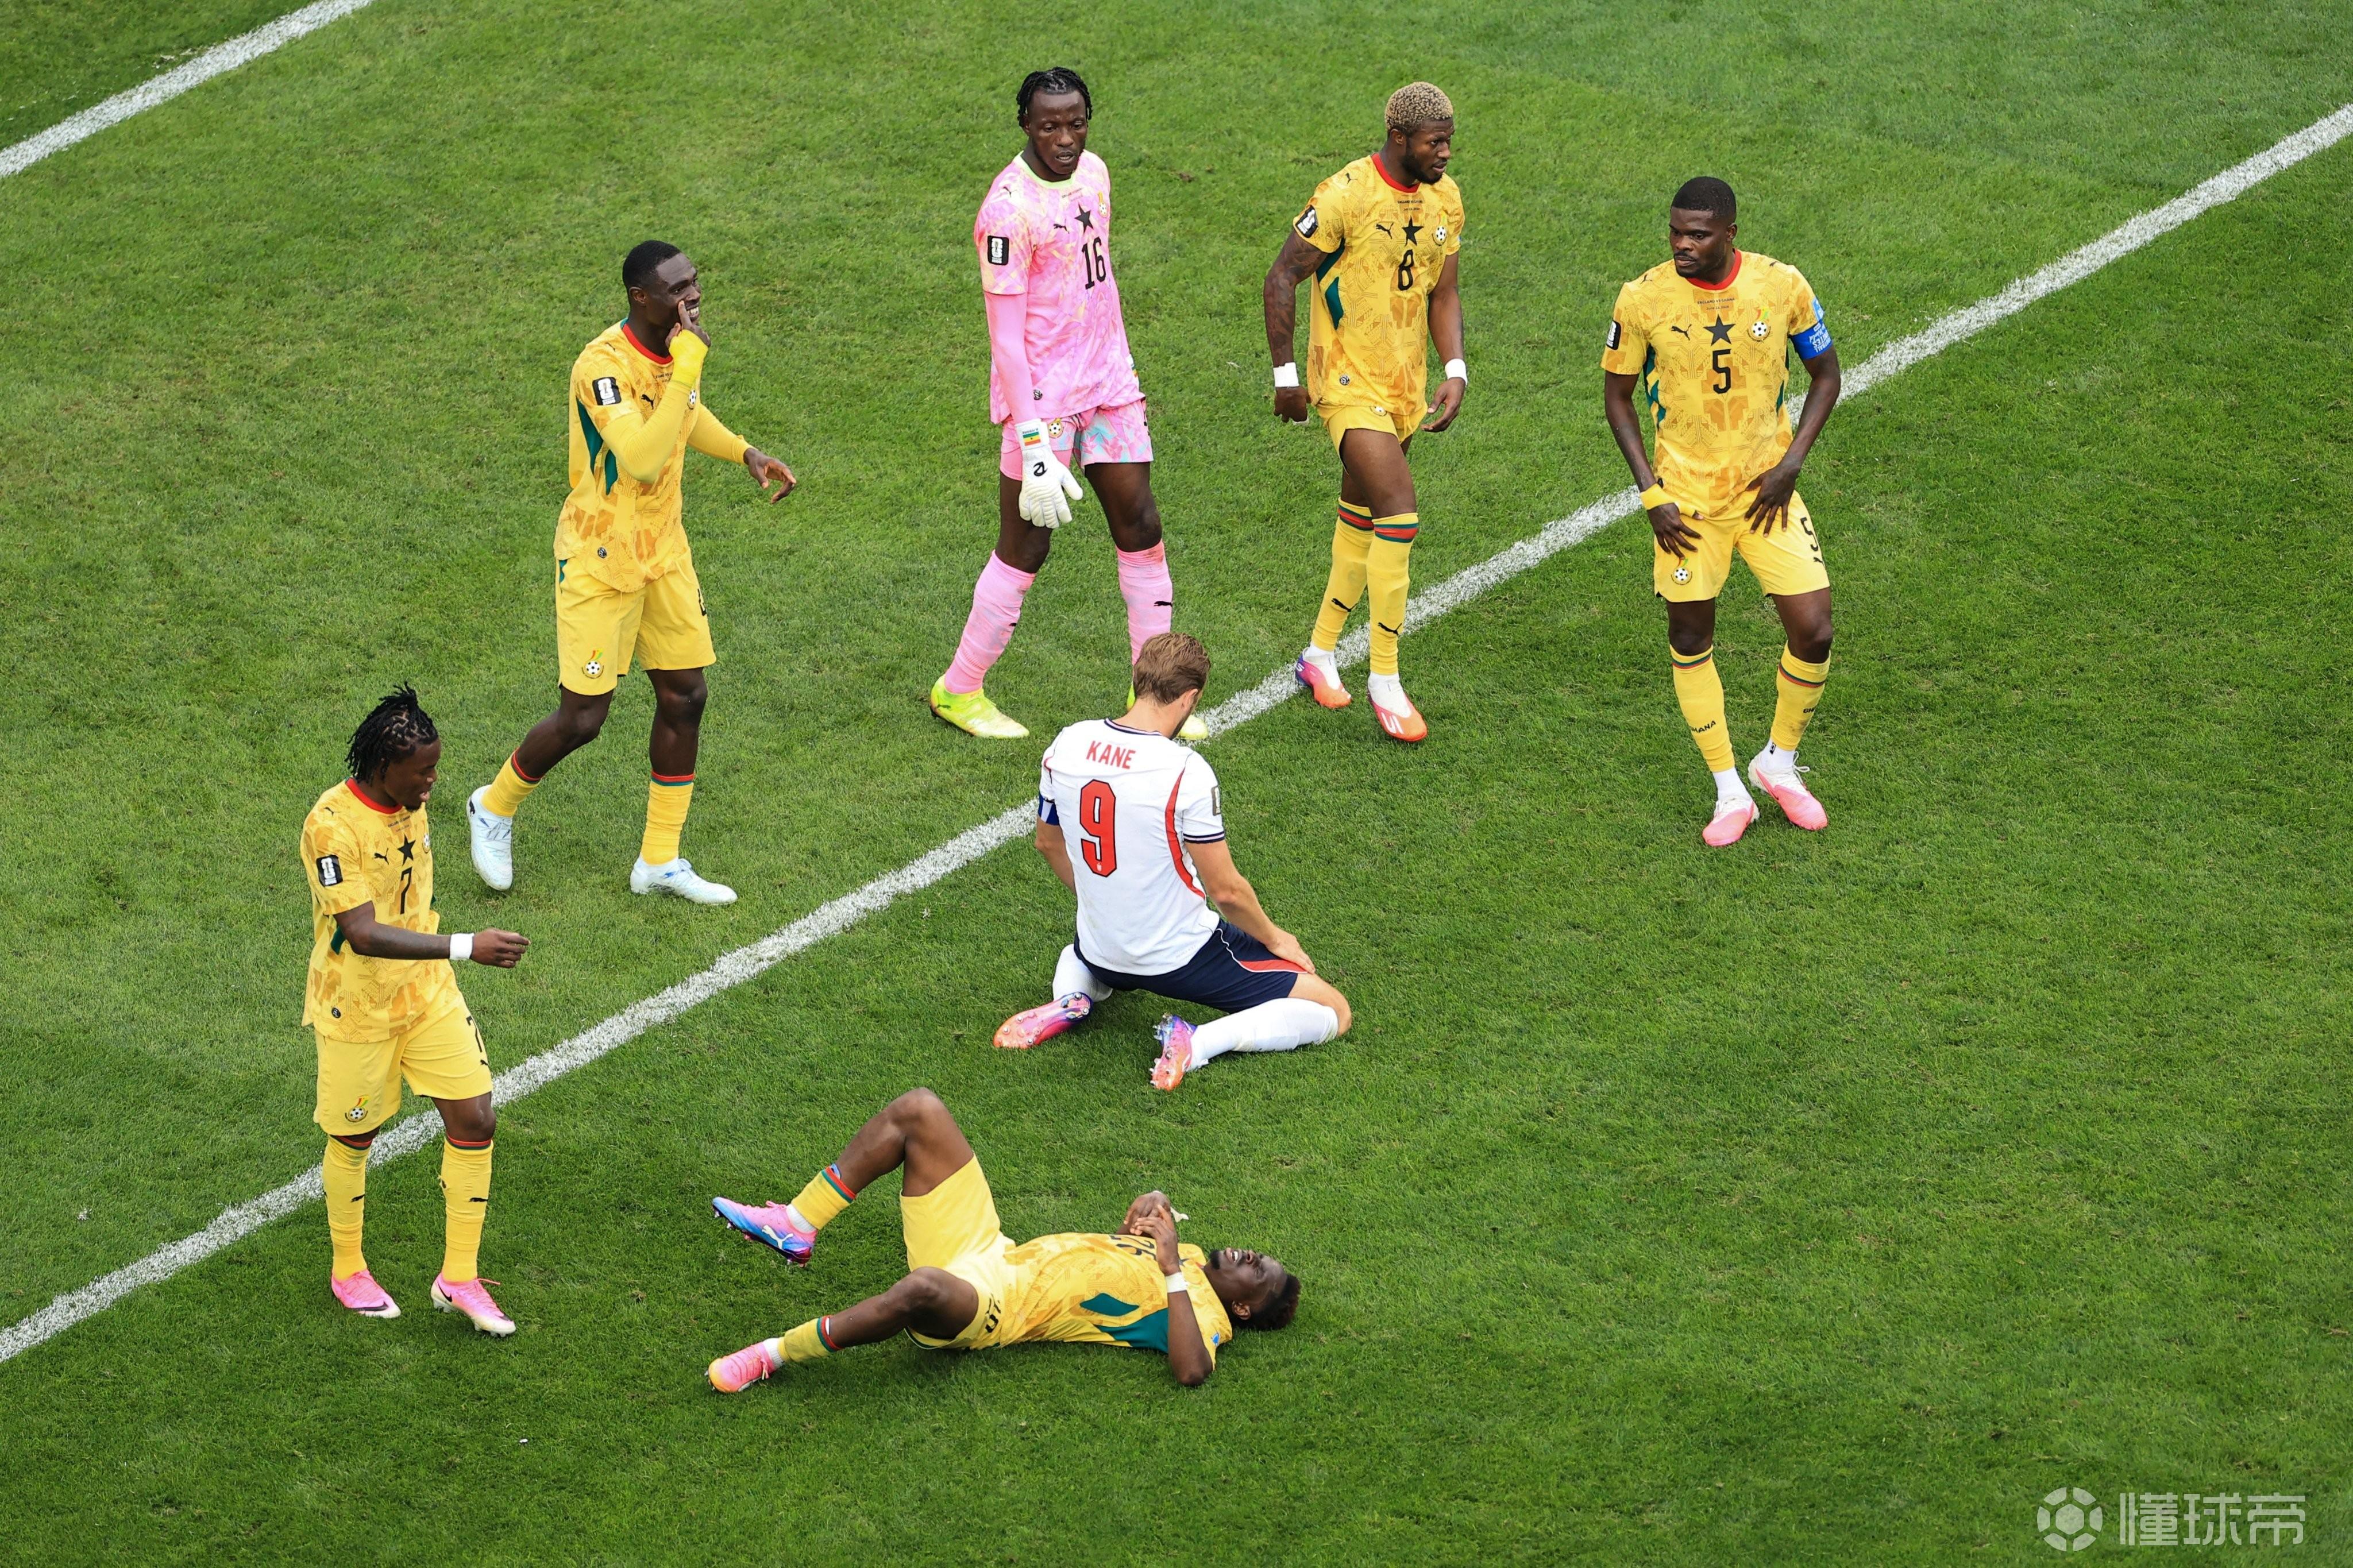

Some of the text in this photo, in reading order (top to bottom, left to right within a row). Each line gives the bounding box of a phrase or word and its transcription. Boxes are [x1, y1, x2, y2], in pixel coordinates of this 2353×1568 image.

[1081, 236, 1106, 290] 16
[1397, 249, 1414, 291] 8
[1712, 348, 1731, 394] 5
[1800, 516, 1819, 552] 5
[1086, 740, 1136, 770] KANE
[1079, 778, 1117, 878] 9
[400, 866, 412, 915] 7
[466, 1015, 483, 1053] 7
